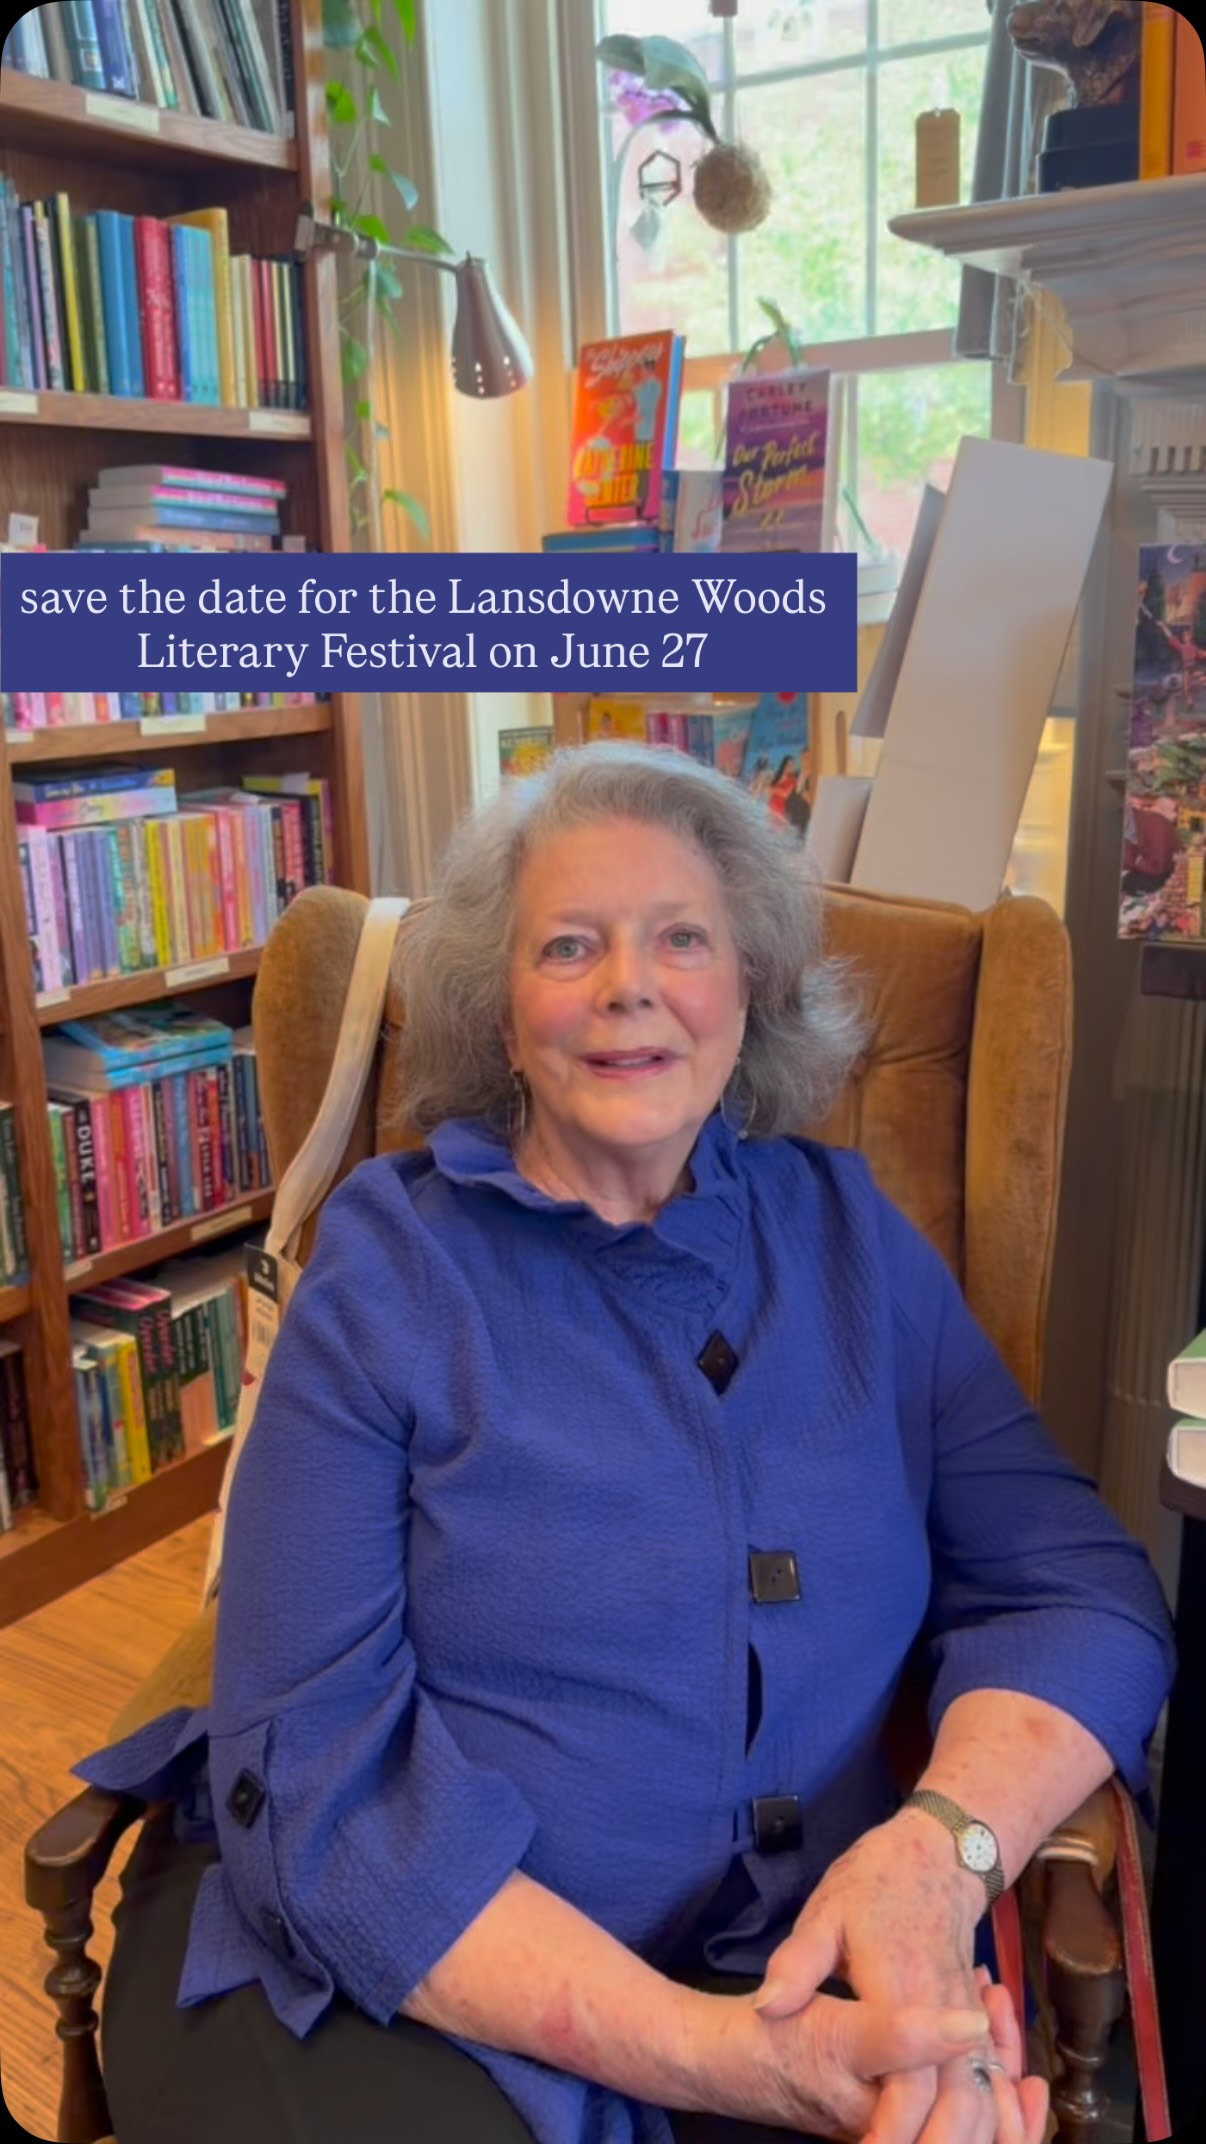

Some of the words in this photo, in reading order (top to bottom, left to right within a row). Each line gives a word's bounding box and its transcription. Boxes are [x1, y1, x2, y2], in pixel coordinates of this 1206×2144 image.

[740, 400, 812, 418] FORTUNE
[745, 383, 807, 400] CARLEY
[733, 442, 760, 467] Our
[761, 431, 819, 473] Perfect
[731, 463, 809, 519] Storm
[76, 1124, 96, 1184] DUKE
